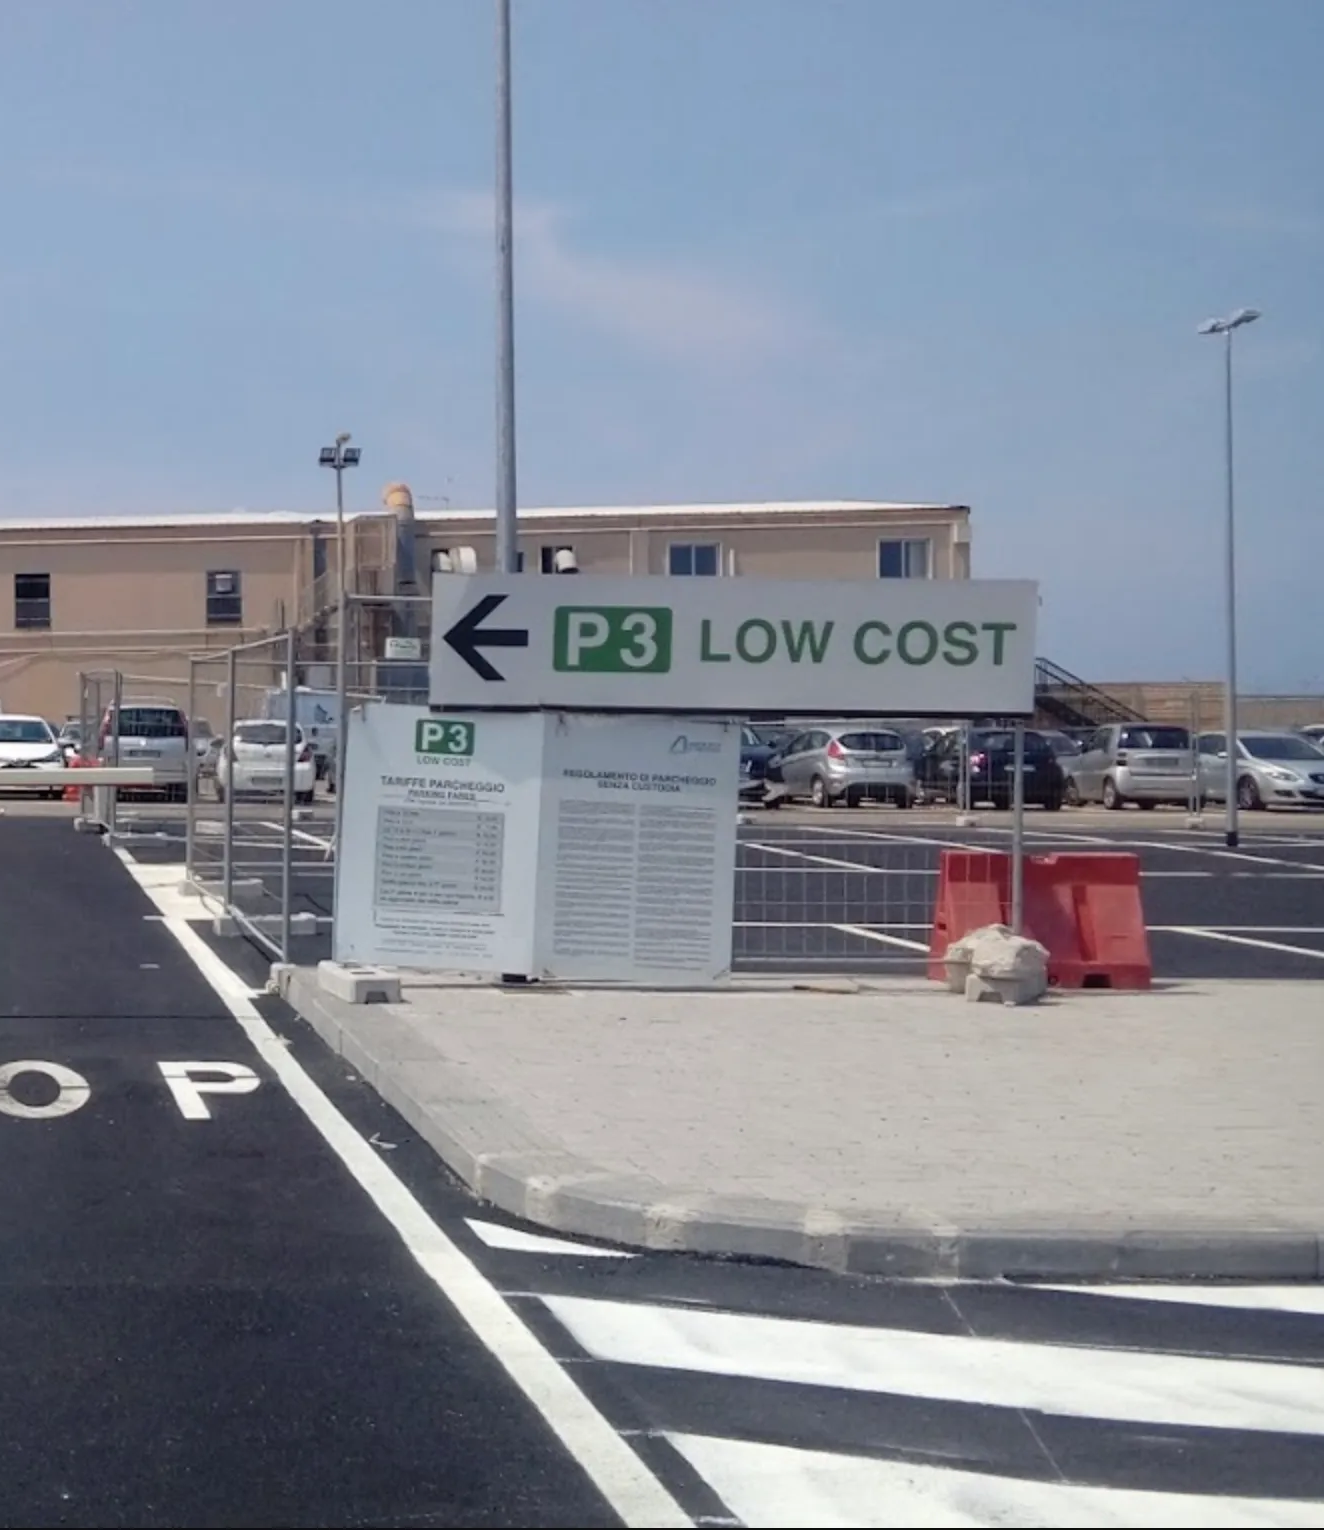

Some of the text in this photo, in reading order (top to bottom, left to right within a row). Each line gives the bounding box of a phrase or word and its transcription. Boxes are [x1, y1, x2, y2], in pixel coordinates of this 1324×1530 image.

[700, 618, 834, 664] LOW
[853, 620, 1017, 667] COST
[417, 755, 471, 767] LOW COST
[380, 775, 505, 793] TARIFFE PARCHEGGIO
[563, 768, 717, 787] REGOLAMENTO DI PARCHEGGIO
[597, 780, 681, 793] SENZA CUSTODIA
